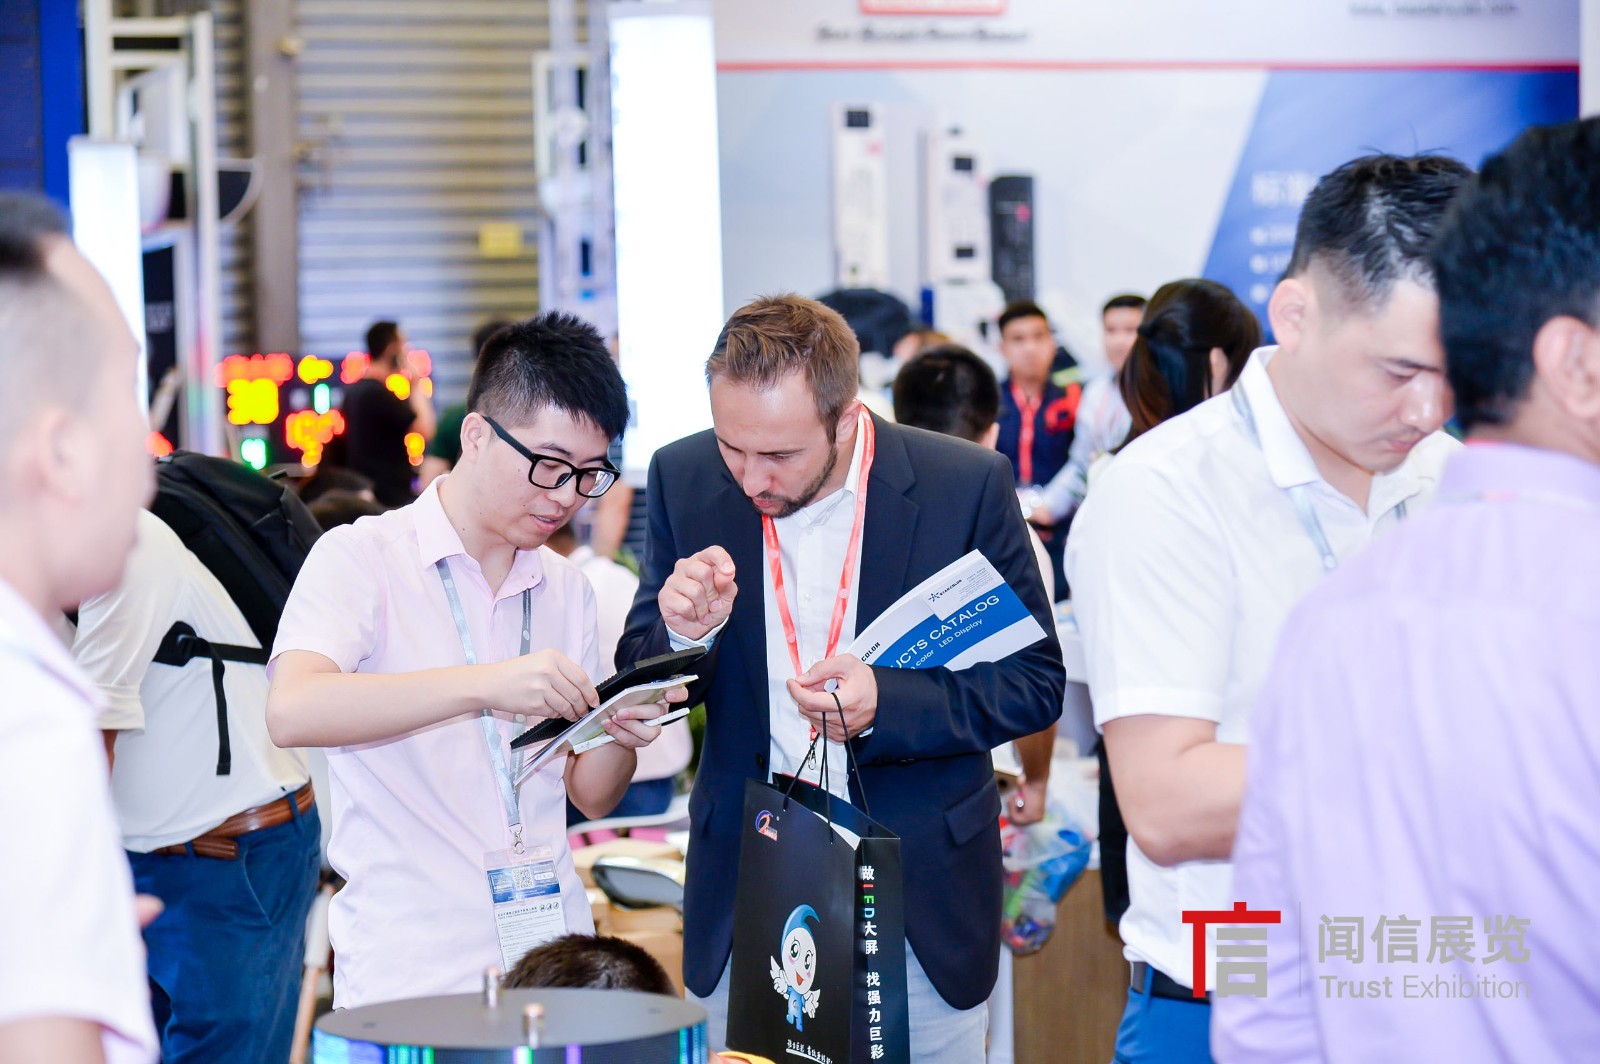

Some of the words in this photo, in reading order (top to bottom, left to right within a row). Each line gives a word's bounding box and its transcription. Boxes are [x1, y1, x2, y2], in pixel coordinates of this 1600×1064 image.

[929, 595, 1000, 640] CATALOG
[861, 641, 881, 662] COLOR
[915, 649, 935, 666] color
[938, 636, 954, 648] LED
[954, 618, 983, 638] Display
[866, 971, 884, 1060] 找强力巨彩
